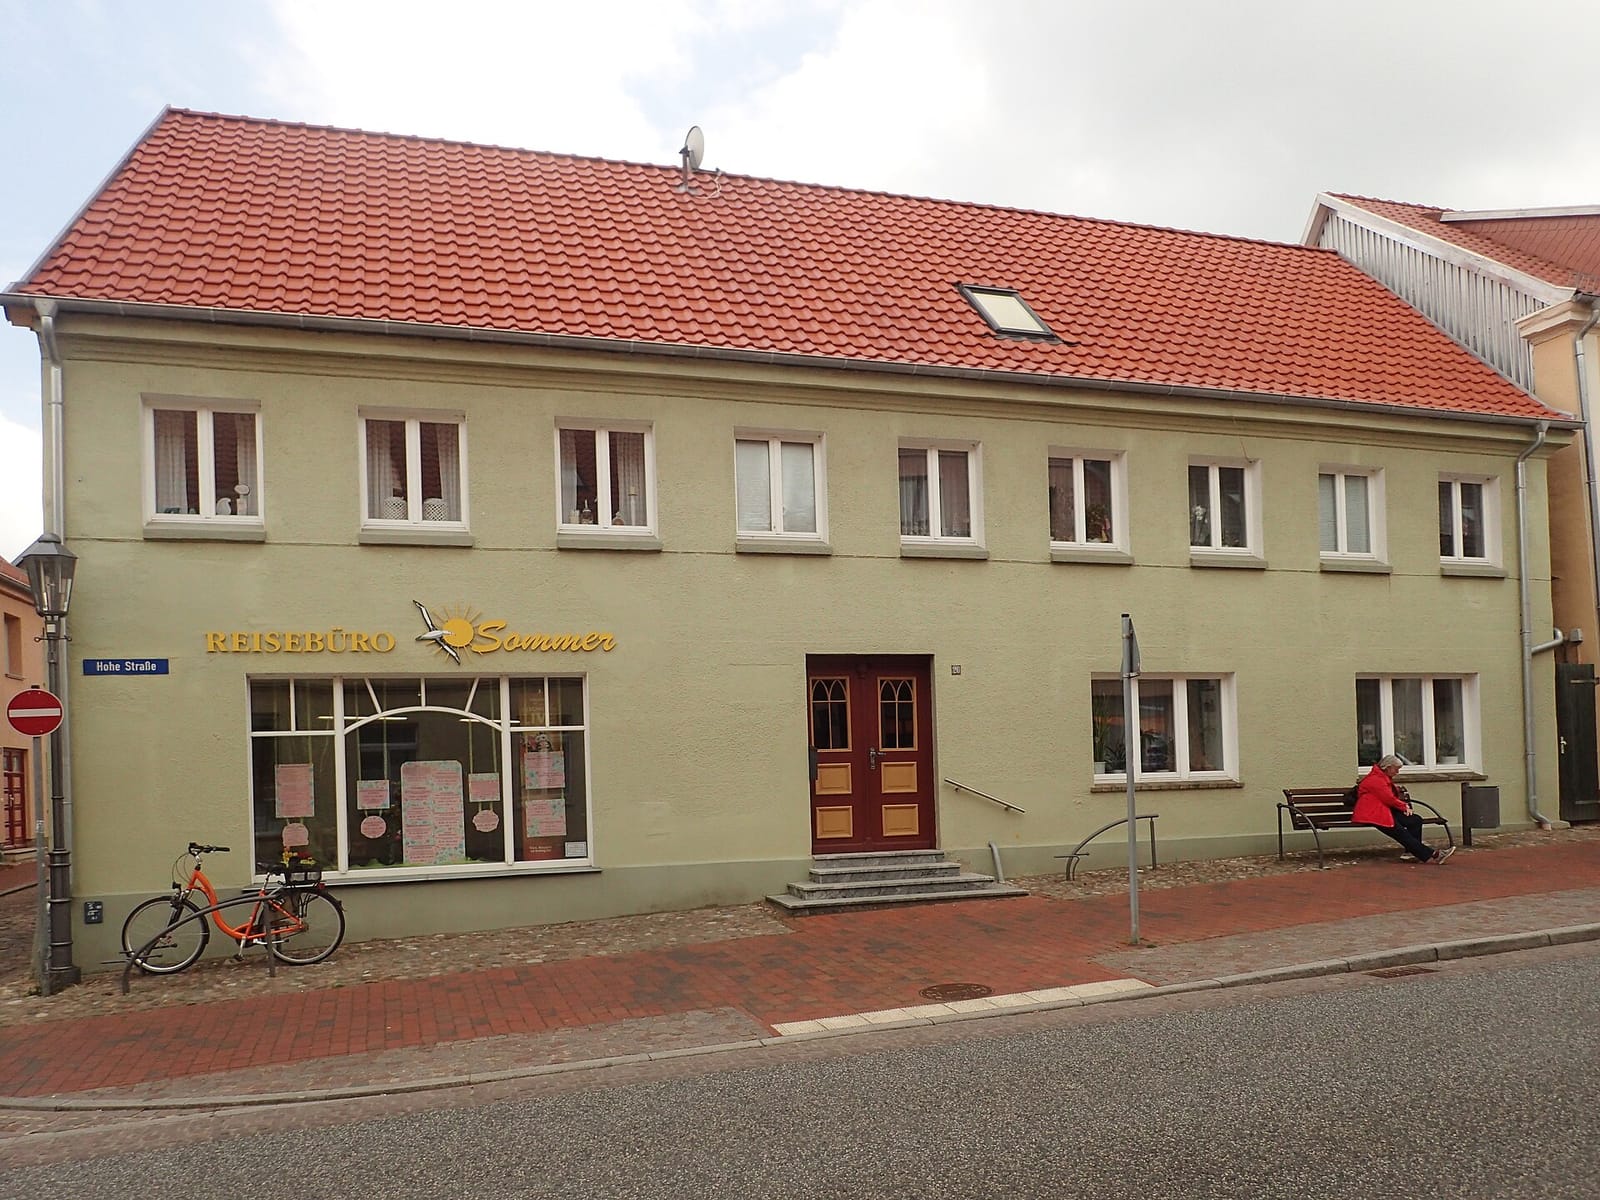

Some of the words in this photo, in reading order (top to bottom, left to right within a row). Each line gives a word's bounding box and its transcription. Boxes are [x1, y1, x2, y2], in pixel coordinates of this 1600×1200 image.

[205, 626, 397, 653] REISEBÜRO
[471, 619, 618, 655] Sommer
[96, 661, 121, 672] Hohe
[124, 661, 157, 672] Straße
